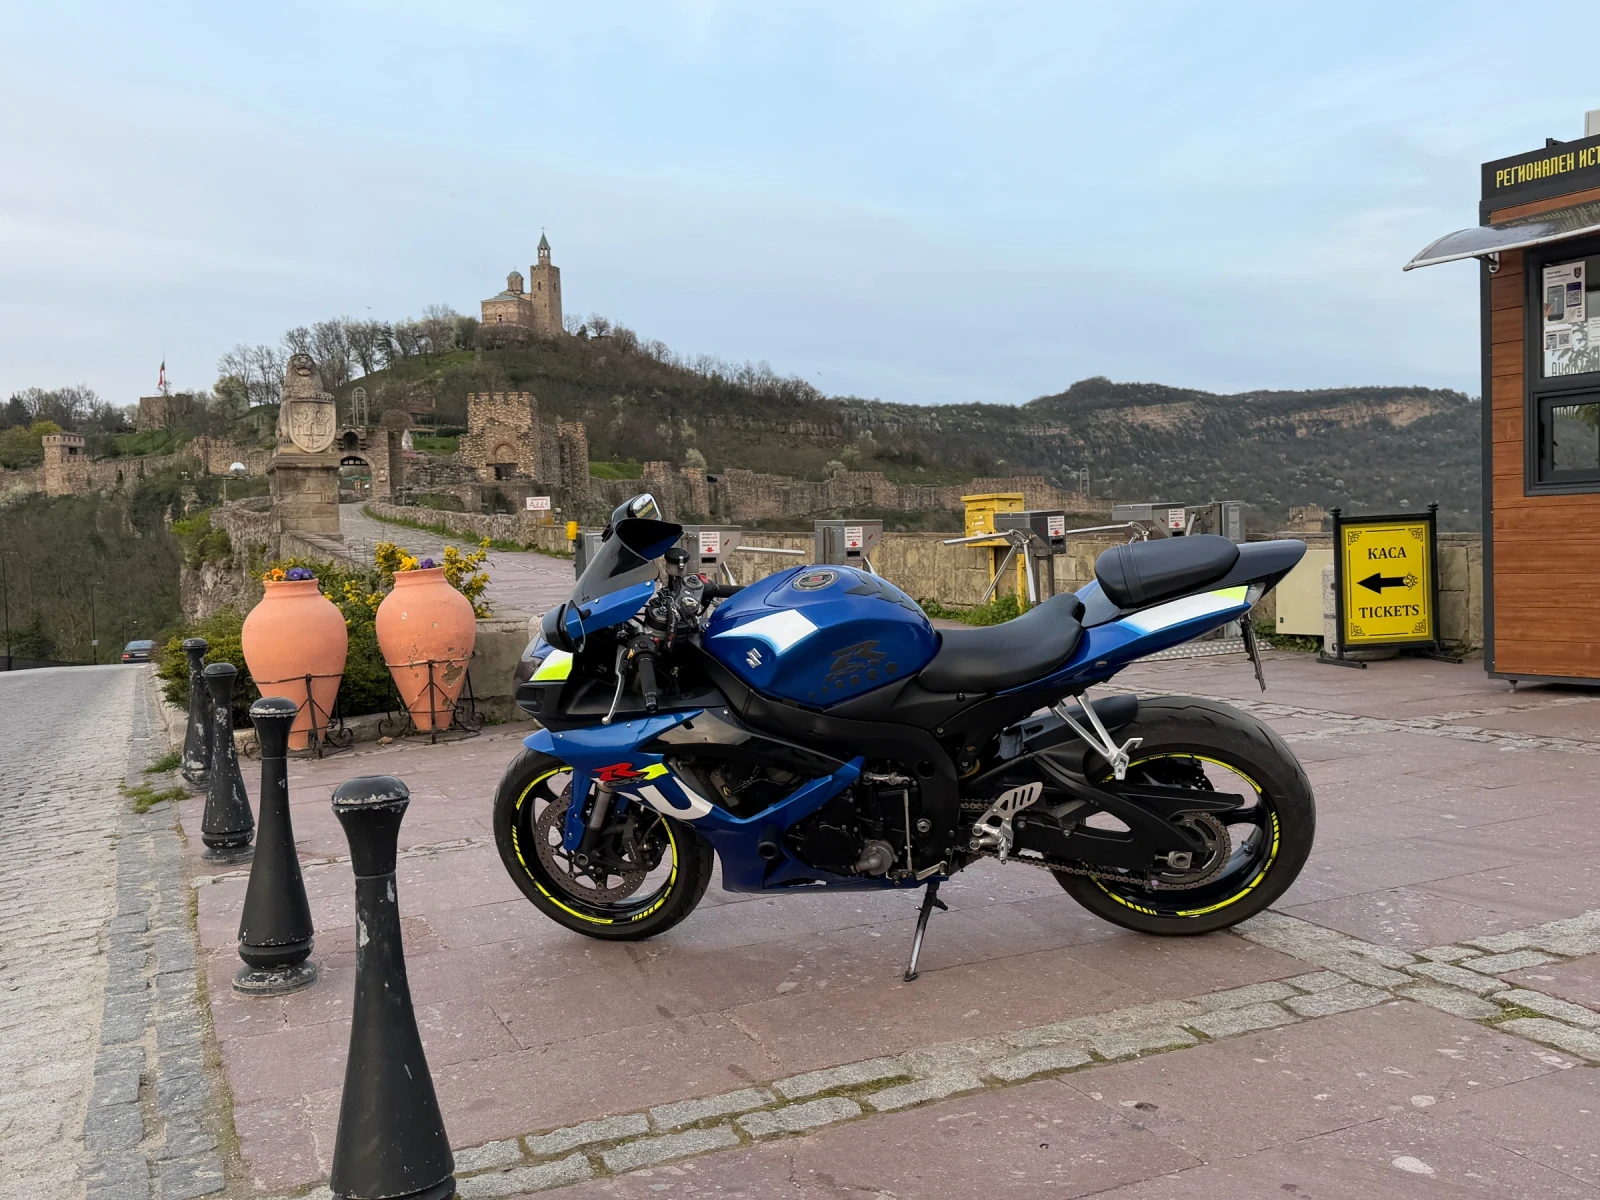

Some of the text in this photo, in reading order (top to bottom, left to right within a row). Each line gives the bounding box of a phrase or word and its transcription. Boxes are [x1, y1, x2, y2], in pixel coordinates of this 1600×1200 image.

[1496, 152, 1575, 188] РЕГИОНАЛЕН
[1367, 546, 1407, 560] КАСА
[1358, 604, 1420, 619] TICKETS
